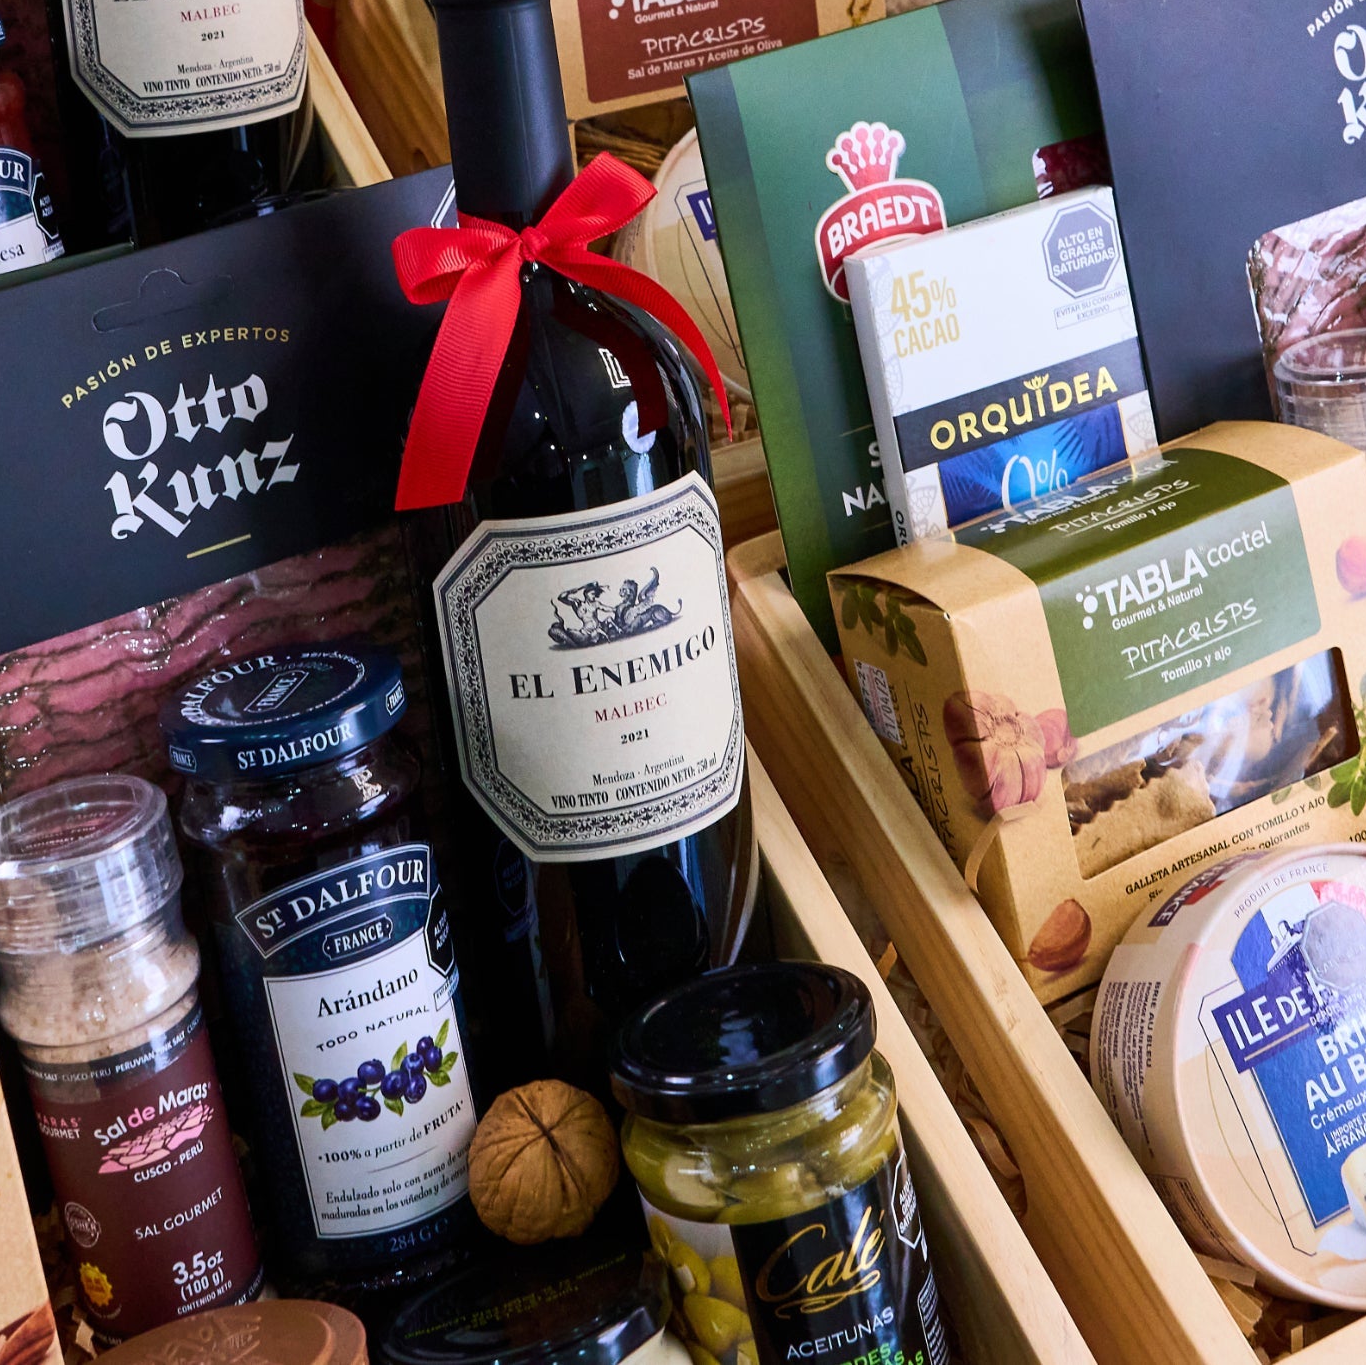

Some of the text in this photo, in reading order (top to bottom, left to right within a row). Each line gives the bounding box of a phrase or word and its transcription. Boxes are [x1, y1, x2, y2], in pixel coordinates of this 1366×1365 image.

[180, 3, 241, 23] MALBEC
[200, 30, 225, 42] 2021
[640, 16, 766, 57] PITACRISPS
[142, 68, 242, 93] VINO TINTO CONTENIDO
[177, 61, 212, 75] Mendoza
[828, 194, 935, 258] BRAEDT
[1057, 226, 1103, 251] ALTO EN
[1052, 247, 1115, 278] SATURADAS
[1059, 238, 1105, 262] GRASAS
[894, 314, 961, 359] CACAO
[61, 327, 291, 409] PASIÓN DE EXPERTOS
[103, 373, 269, 461] Otto
[104, 433, 301, 540] Kunz
[1097, 523, 1272, 618] TABLA coctel
[1121, 598, 1258, 671] PITACRISPS
[509, 624, 716, 699] EL ENEMIGO
[1160, 645, 1232, 685] Tomillo ajo
[594, 693, 668, 724] MALBEC
[1125, 810, 1299, 895] GALLETA ARTESANAL CON TOMILLO
[255, 860, 427, 940] ST DALFOUR
[332, 922, 385, 956] FRANCE
[317, 967, 419, 1018] Arándano
[366, 1004, 430, 1033] NATURAL
[94, 1081, 209, 1147] Sal de Maras
[134, 1160, 172, 1183] CUSCO
[164, 1186, 224, 1232] GOURMET
[756, 1205, 886, 1304] Calé
